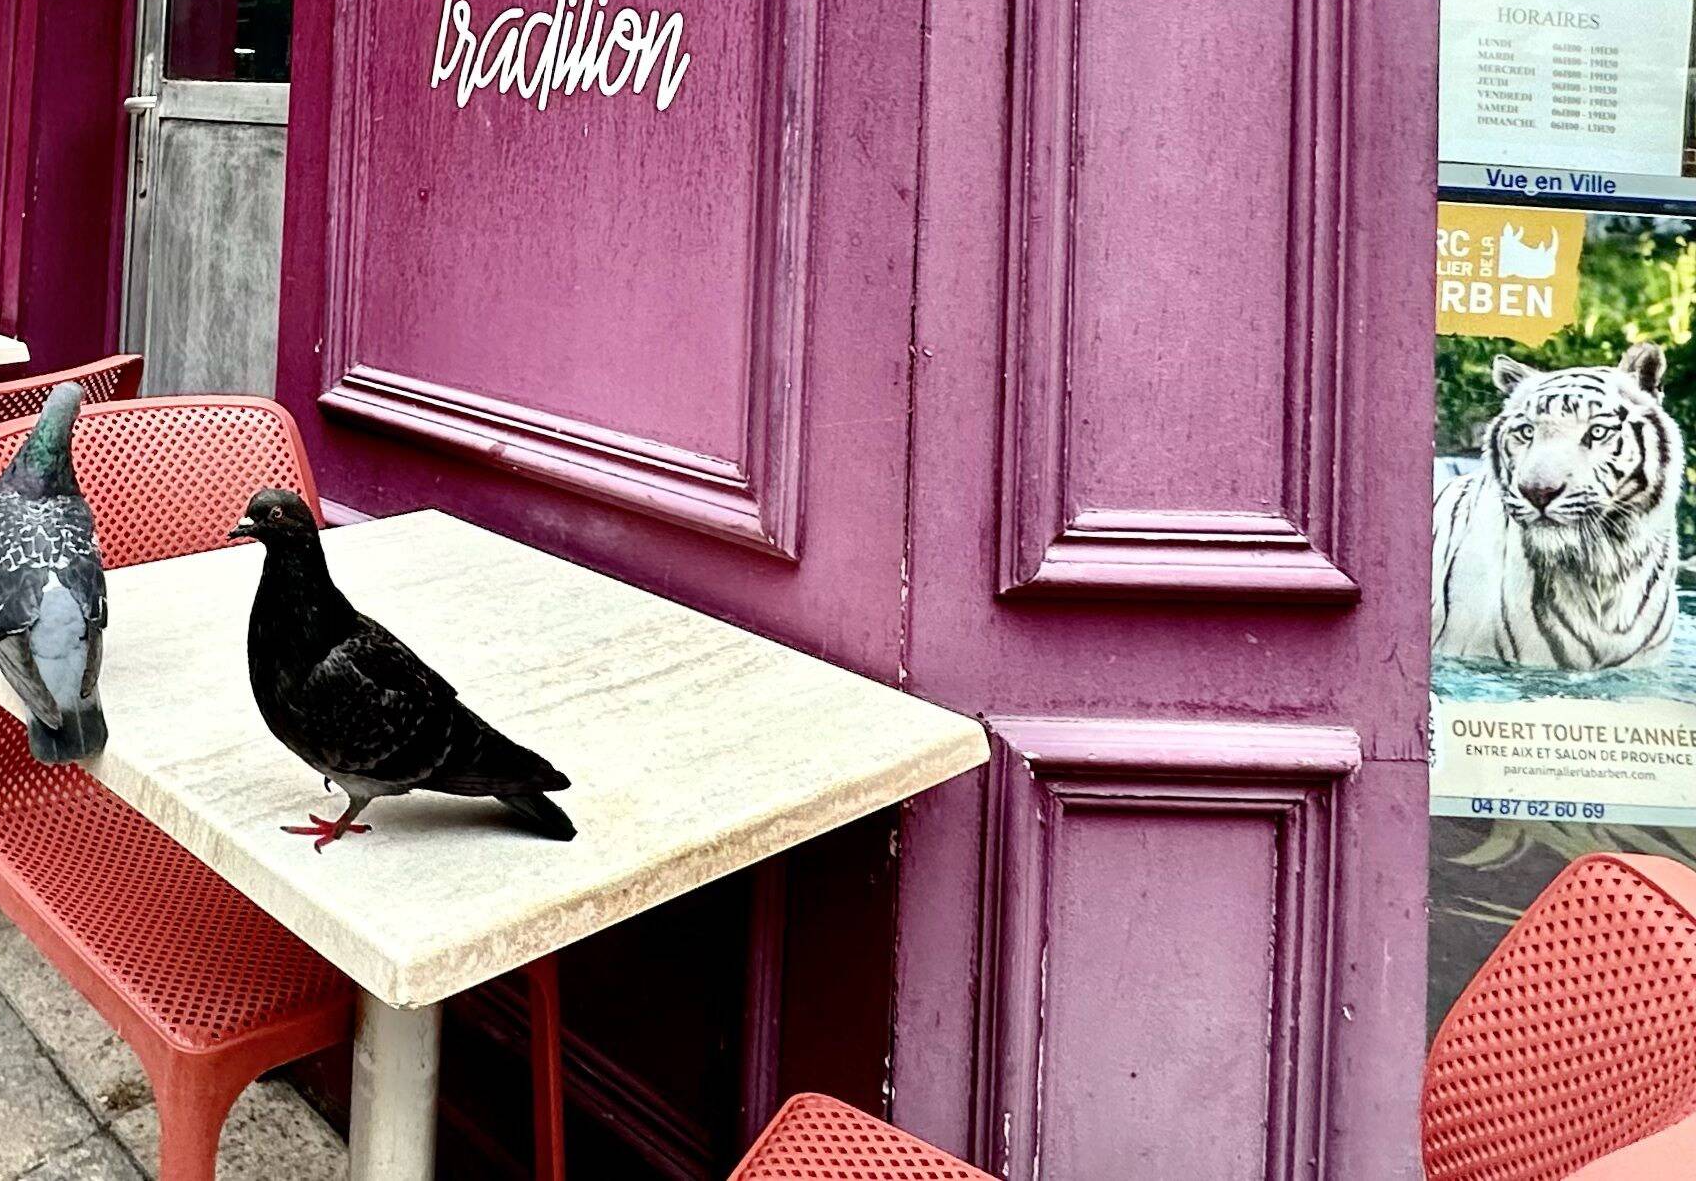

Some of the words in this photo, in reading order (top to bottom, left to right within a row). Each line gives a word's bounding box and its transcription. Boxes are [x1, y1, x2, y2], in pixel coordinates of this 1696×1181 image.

[1497, 7, 1601, 30] HORAIRES
[1478, 37, 1512, 48] LUNDI
[1478, 50, 1515, 61] MARDI
[1478, 64, 1536, 76] MERCREDI
[1477, 77, 1509, 87] JEUDI
[1477, 89, 1533, 102] VENDREDI
[1477, 103, 1519, 114] SAMEDI
[1477, 116, 1536, 128] DIMANCHE
[1486, 168, 1528, 189] Vue
[1535, 175, 1562, 190] en
[1570, 173, 1616, 194] Ville
[1452, 719, 1536, 740] OUVERT
[1542, 723, 1608, 743] TOUTE
[1465, 744, 1509, 757] ENTRE
[1512, 746, 1534, 758] AIX
[1537, 747, 1552, 759] ET
[1555, 748, 1597, 761] SALON
[1601, 749, 1617, 762] DE
[1621, 750, 1693, 765] PROVENCE
[1471, 797, 1493, 814] 04
[1499, 798, 1521, 815] 87
[1527, 800, 1549, 817] 62
[1555, 801, 1577, 818] 60
[1583, 802, 1605, 819] 69
